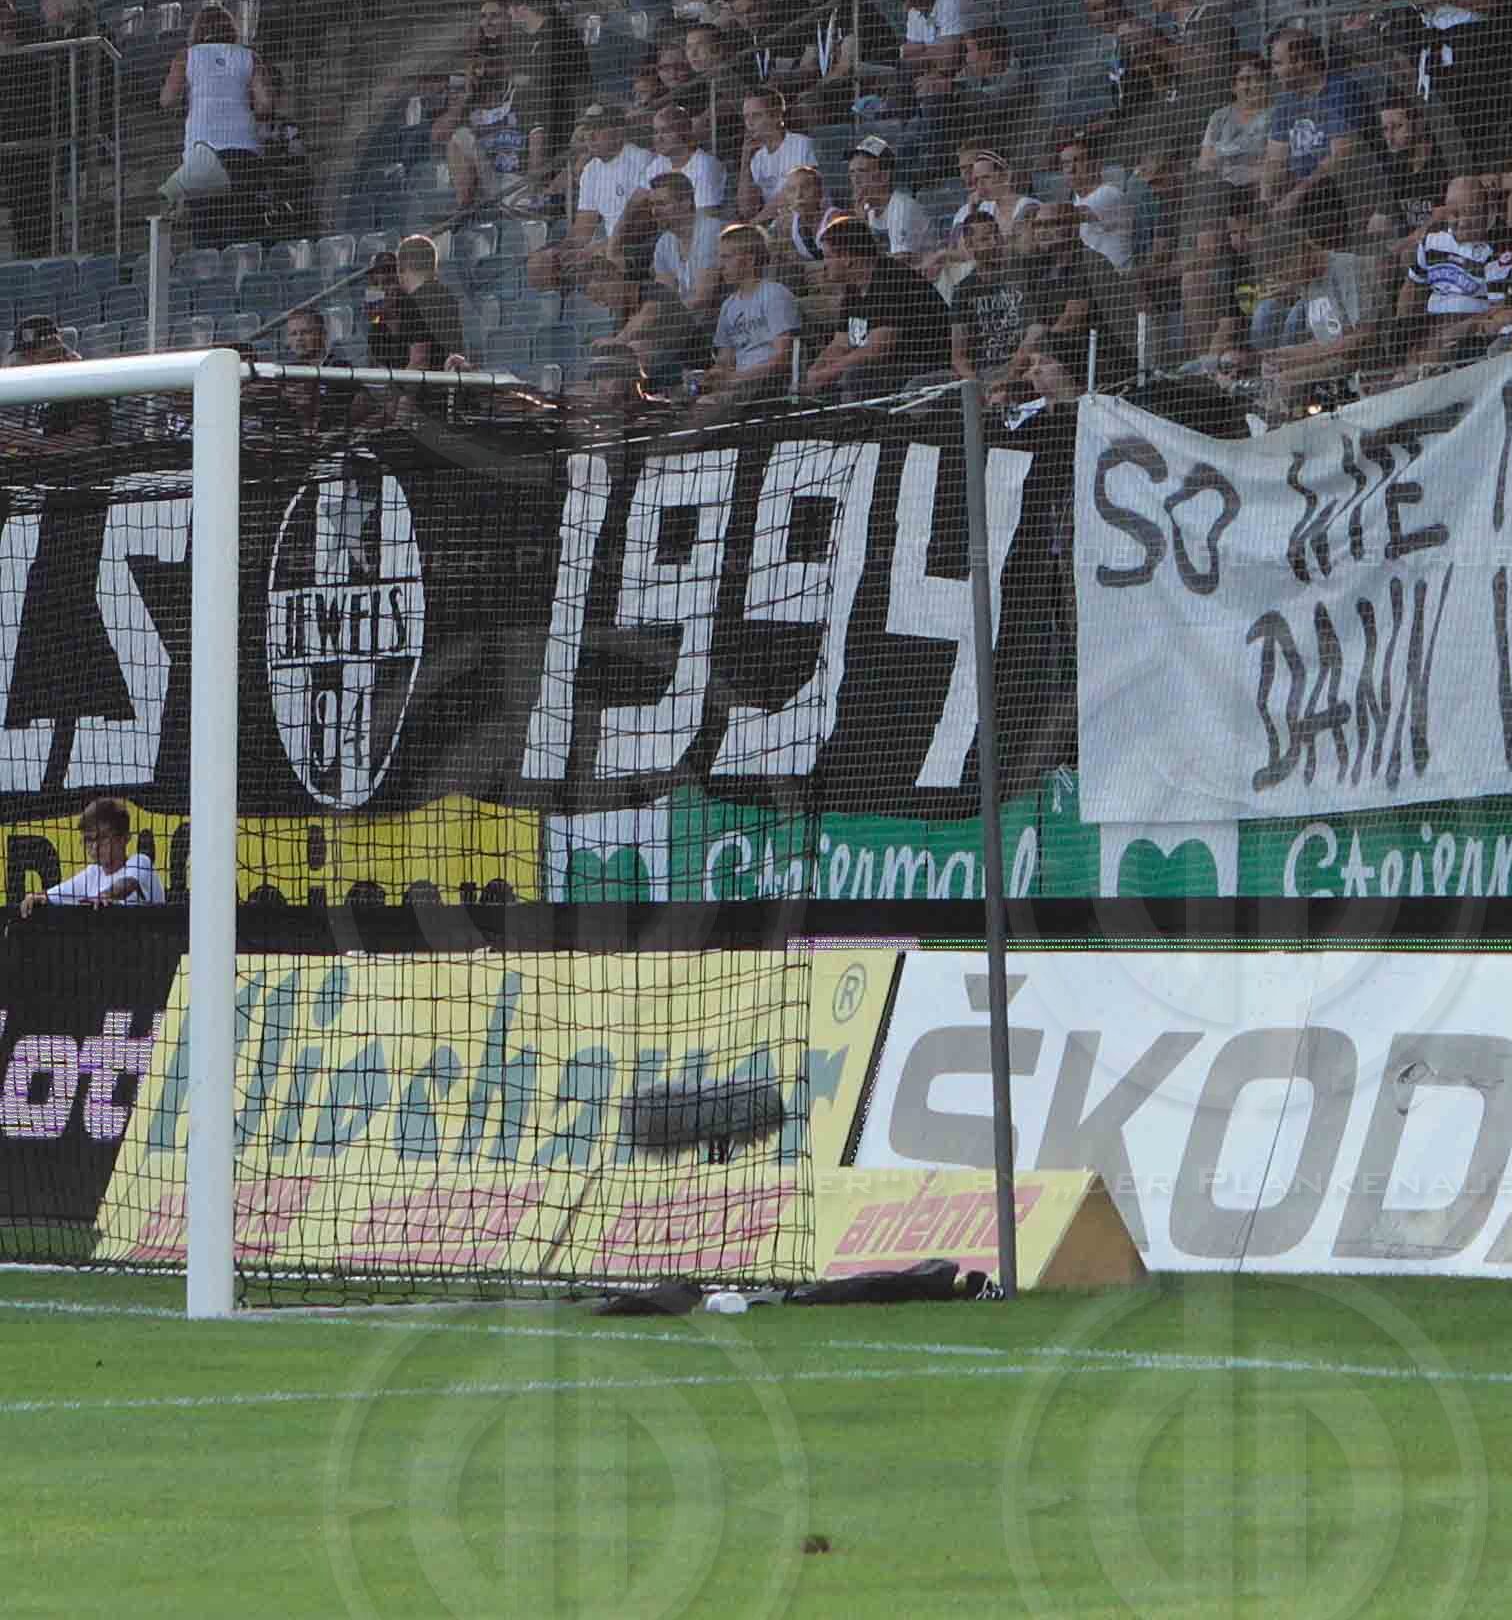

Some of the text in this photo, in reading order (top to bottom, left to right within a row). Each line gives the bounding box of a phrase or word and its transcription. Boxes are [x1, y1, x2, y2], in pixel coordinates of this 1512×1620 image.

[521, 441, 1034, 788] 1994
[1094, 436, 1241, 595] SO
[1246, 560, 1455, 794] DANN
